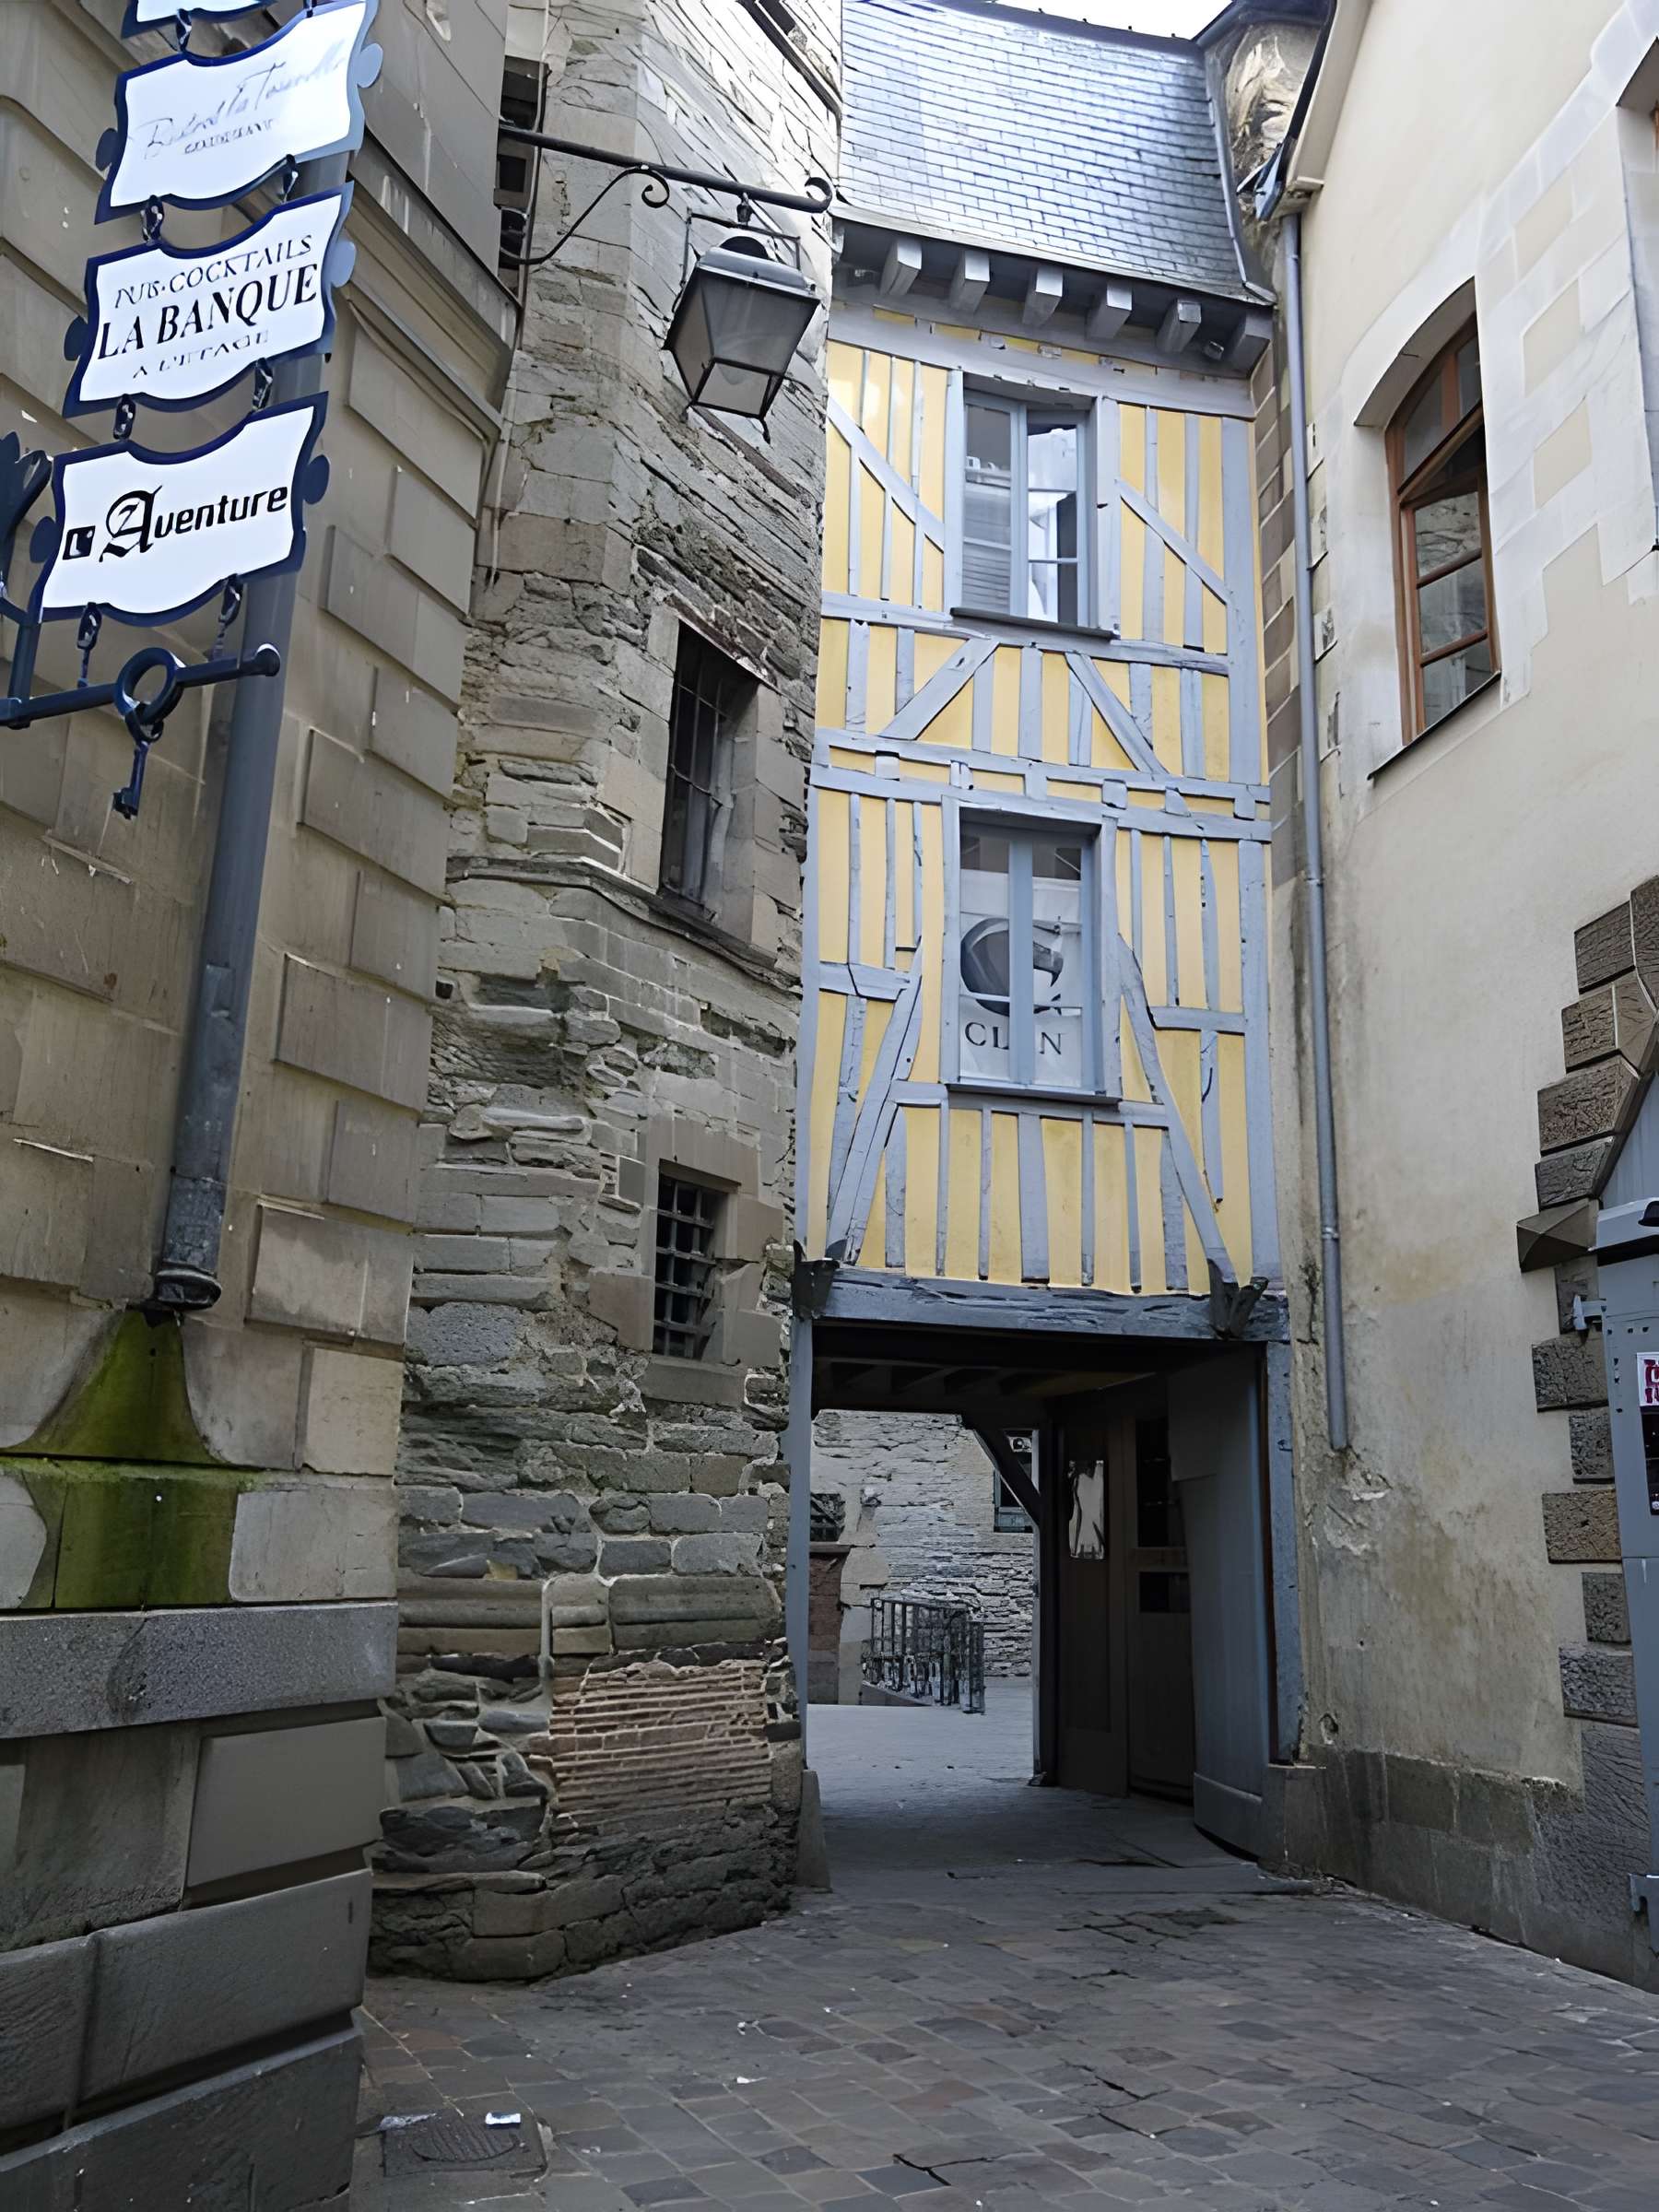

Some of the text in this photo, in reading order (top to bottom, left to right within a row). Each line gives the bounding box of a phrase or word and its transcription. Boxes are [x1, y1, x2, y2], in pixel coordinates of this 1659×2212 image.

[98, 264, 318, 359] LA BANQUE
[964, 1021, 1063, 1055] CLN
